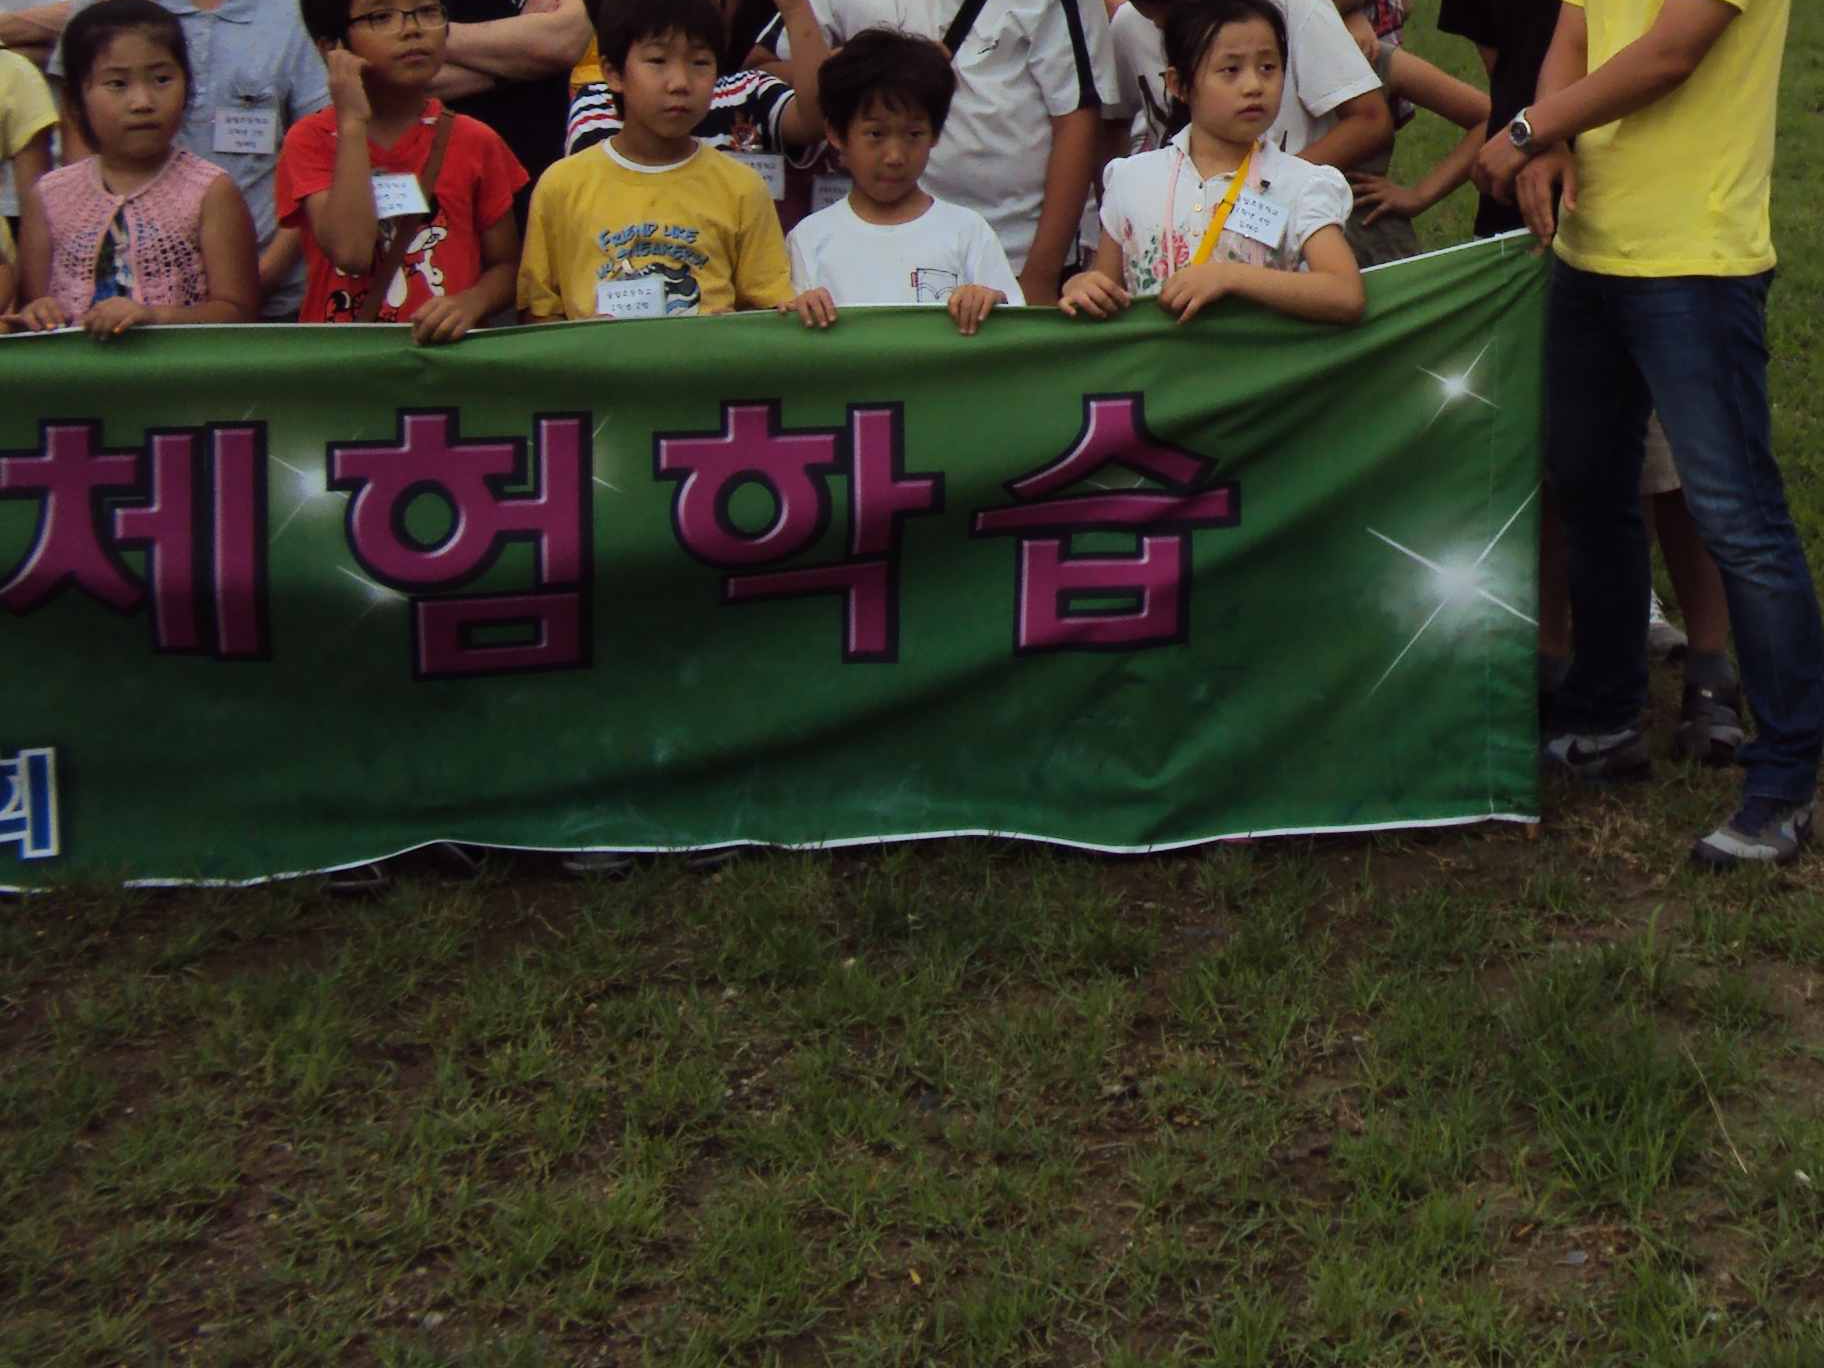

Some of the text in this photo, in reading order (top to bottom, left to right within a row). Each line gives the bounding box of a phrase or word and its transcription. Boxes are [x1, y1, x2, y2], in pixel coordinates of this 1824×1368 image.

[598, 221, 700, 252] FRIEND LIKE
[0, 391, 1241, 681] 체험학습
